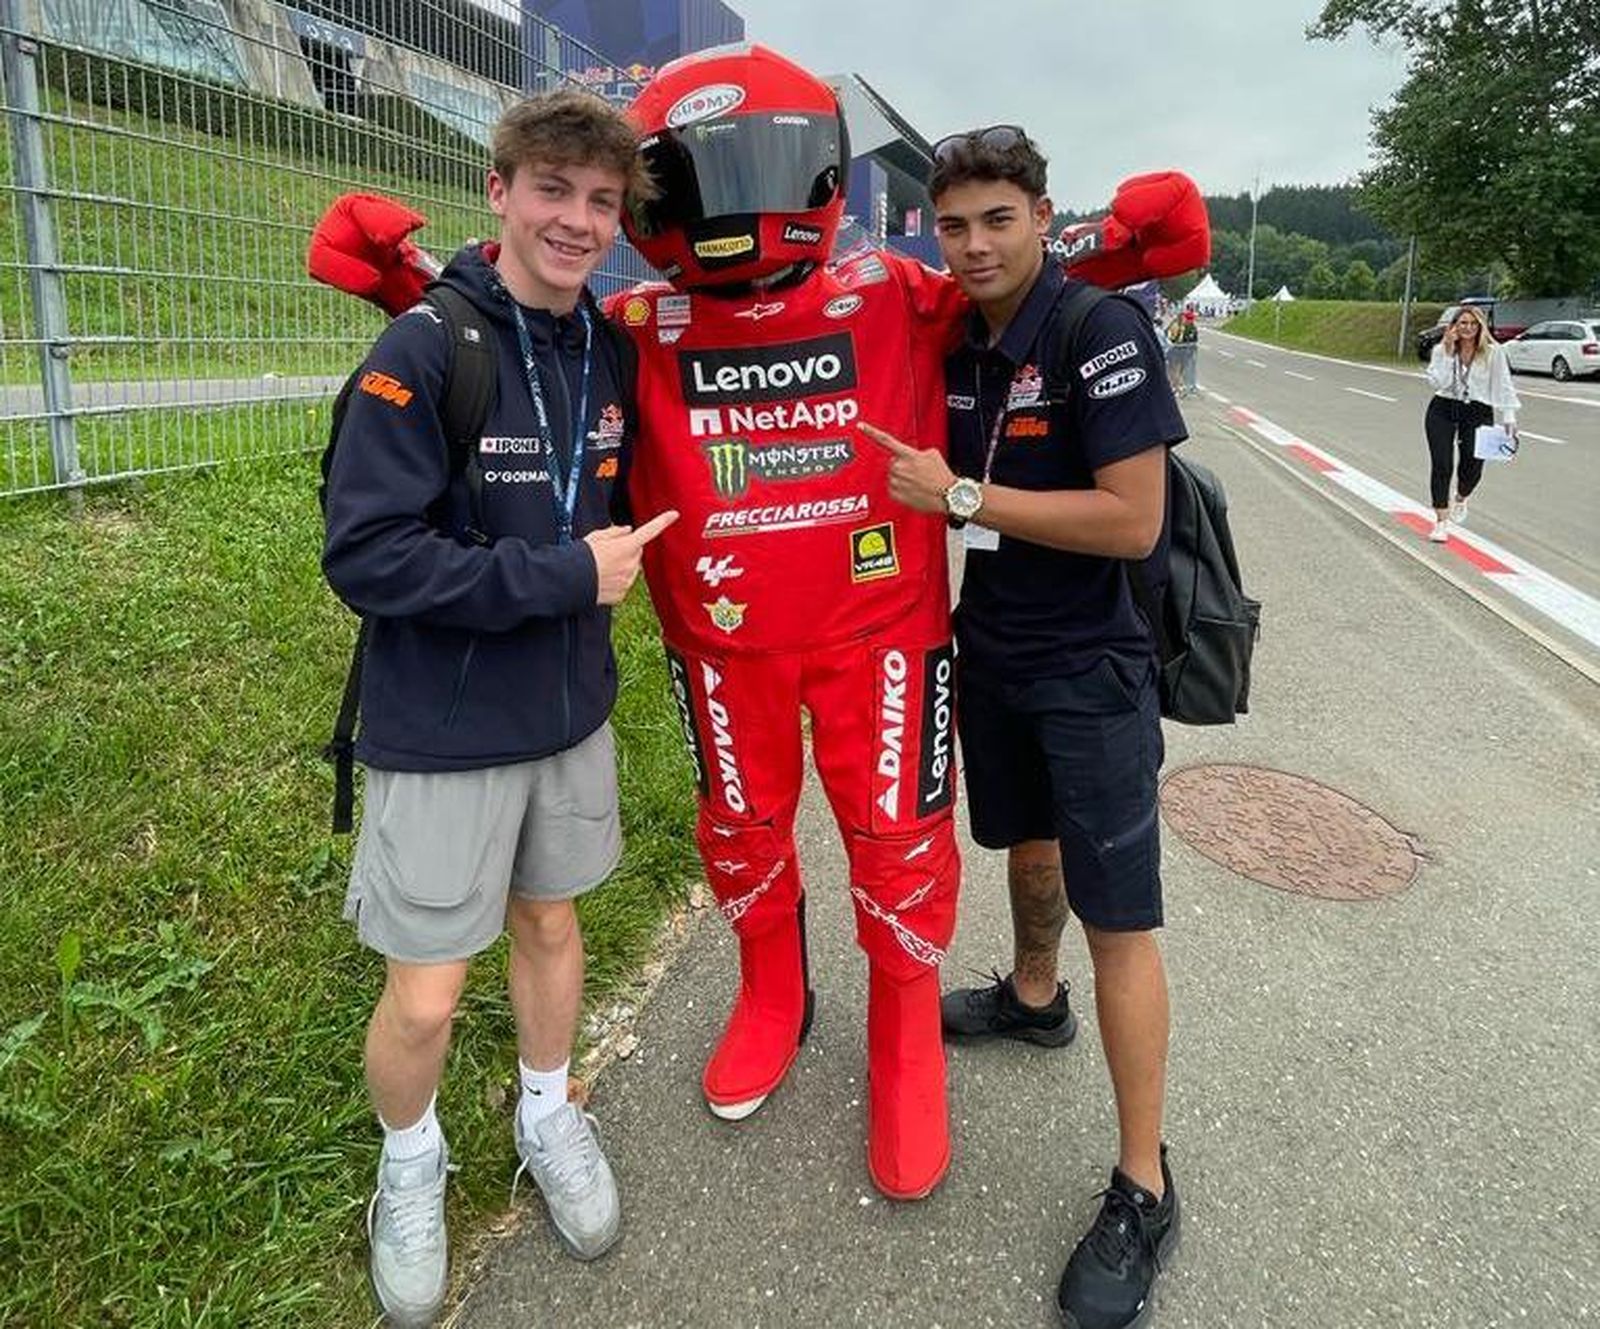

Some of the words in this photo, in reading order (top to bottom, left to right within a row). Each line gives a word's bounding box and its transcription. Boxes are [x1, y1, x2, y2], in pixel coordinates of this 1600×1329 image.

[784, 226, 820, 242] Lenovo
[1046, 233, 1096, 257] Leno
[1093, 344, 1135, 370] IPONE
[693, 353, 842, 393] Lenovo
[1098, 372, 1137, 393] HJC
[361, 370, 413, 407] KTM
[729, 398, 859, 433] NetApp
[496, 440, 537, 451] IPONE
[748, 443, 849, 467] MONSTER
[705, 494, 869, 529] FRECCIAROSSA
[926, 659, 950, 802] Lenovo
